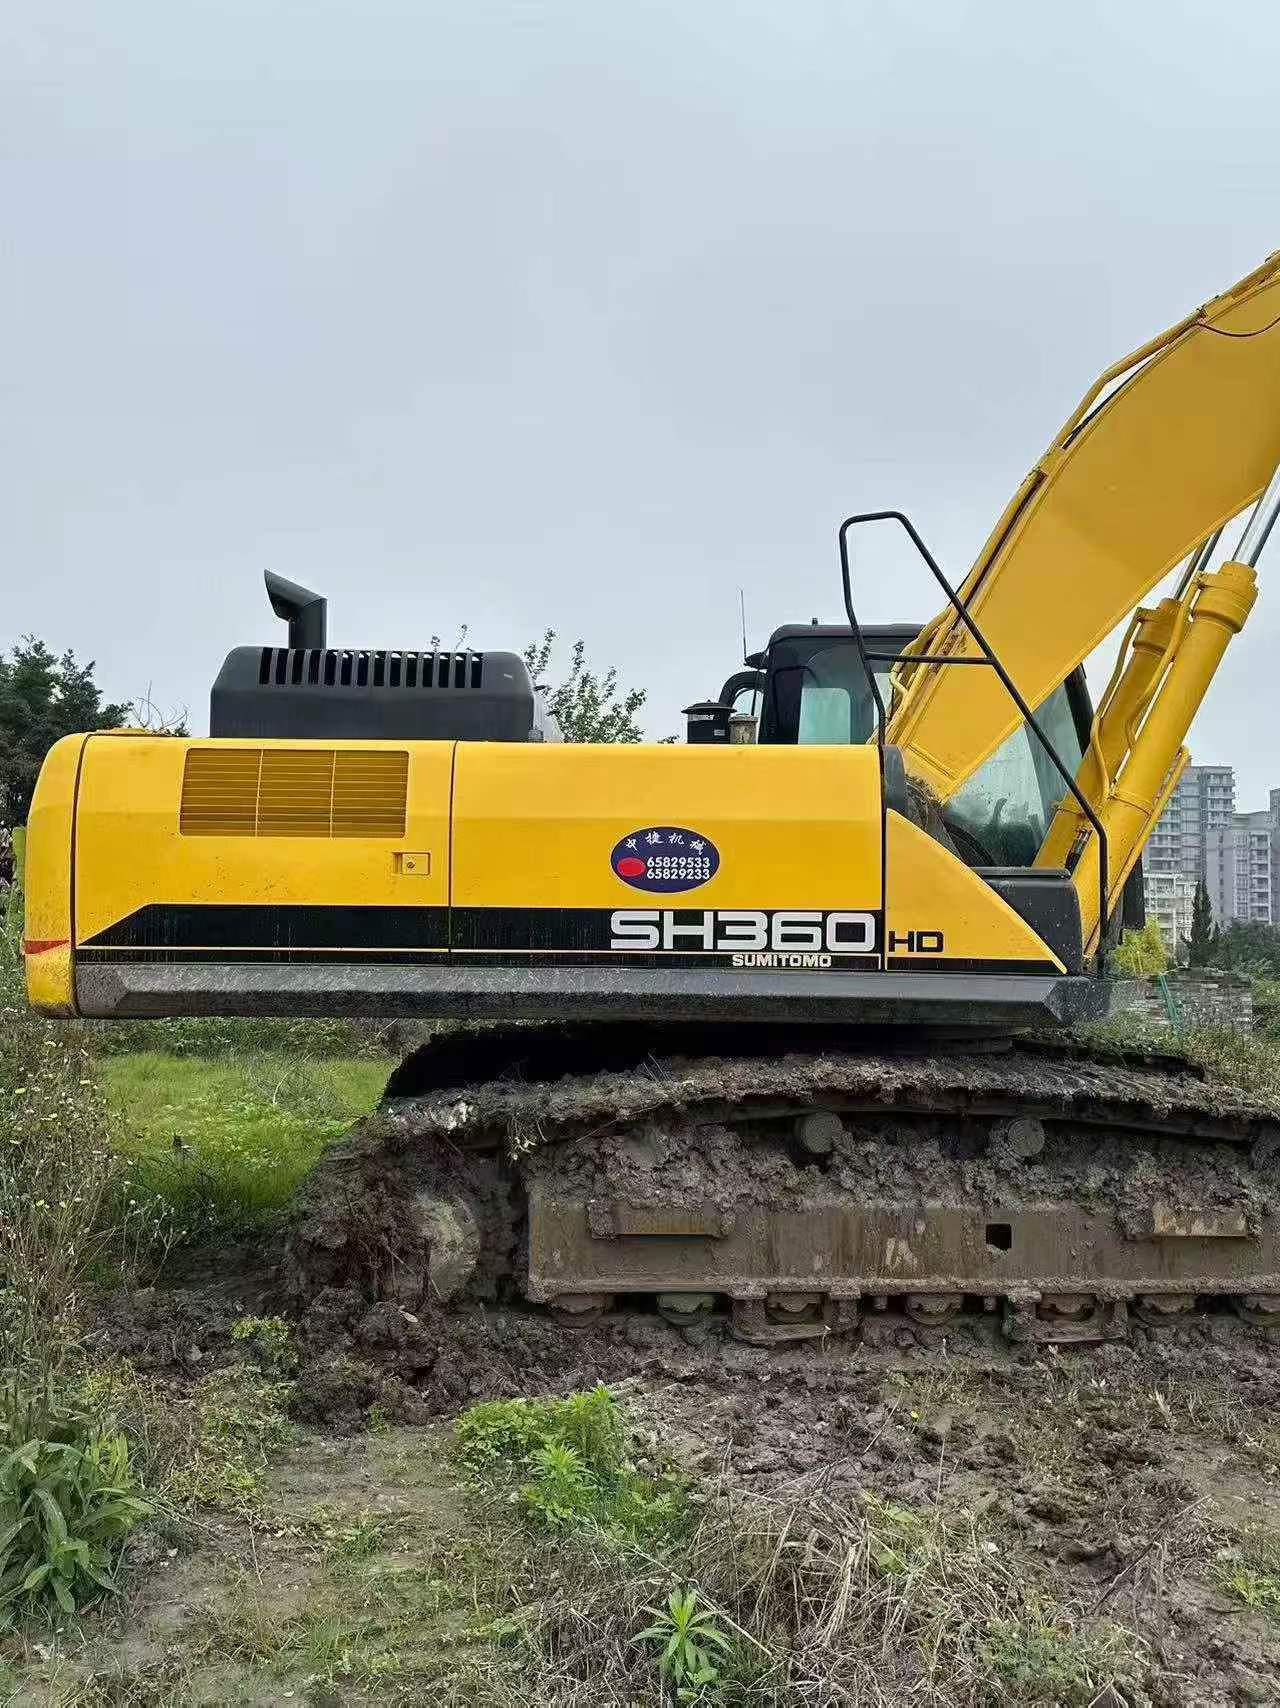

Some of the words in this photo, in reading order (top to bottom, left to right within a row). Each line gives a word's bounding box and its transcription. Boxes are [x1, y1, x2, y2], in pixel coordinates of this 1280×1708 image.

[646, 856, 711, 868] 65829533
[646, 868, 711, 880] 65829233
[610, 910, 876, 951] SH360
[888, 930, 944, 953] HD
[732, 953, 832, 968] SUMITOMO
